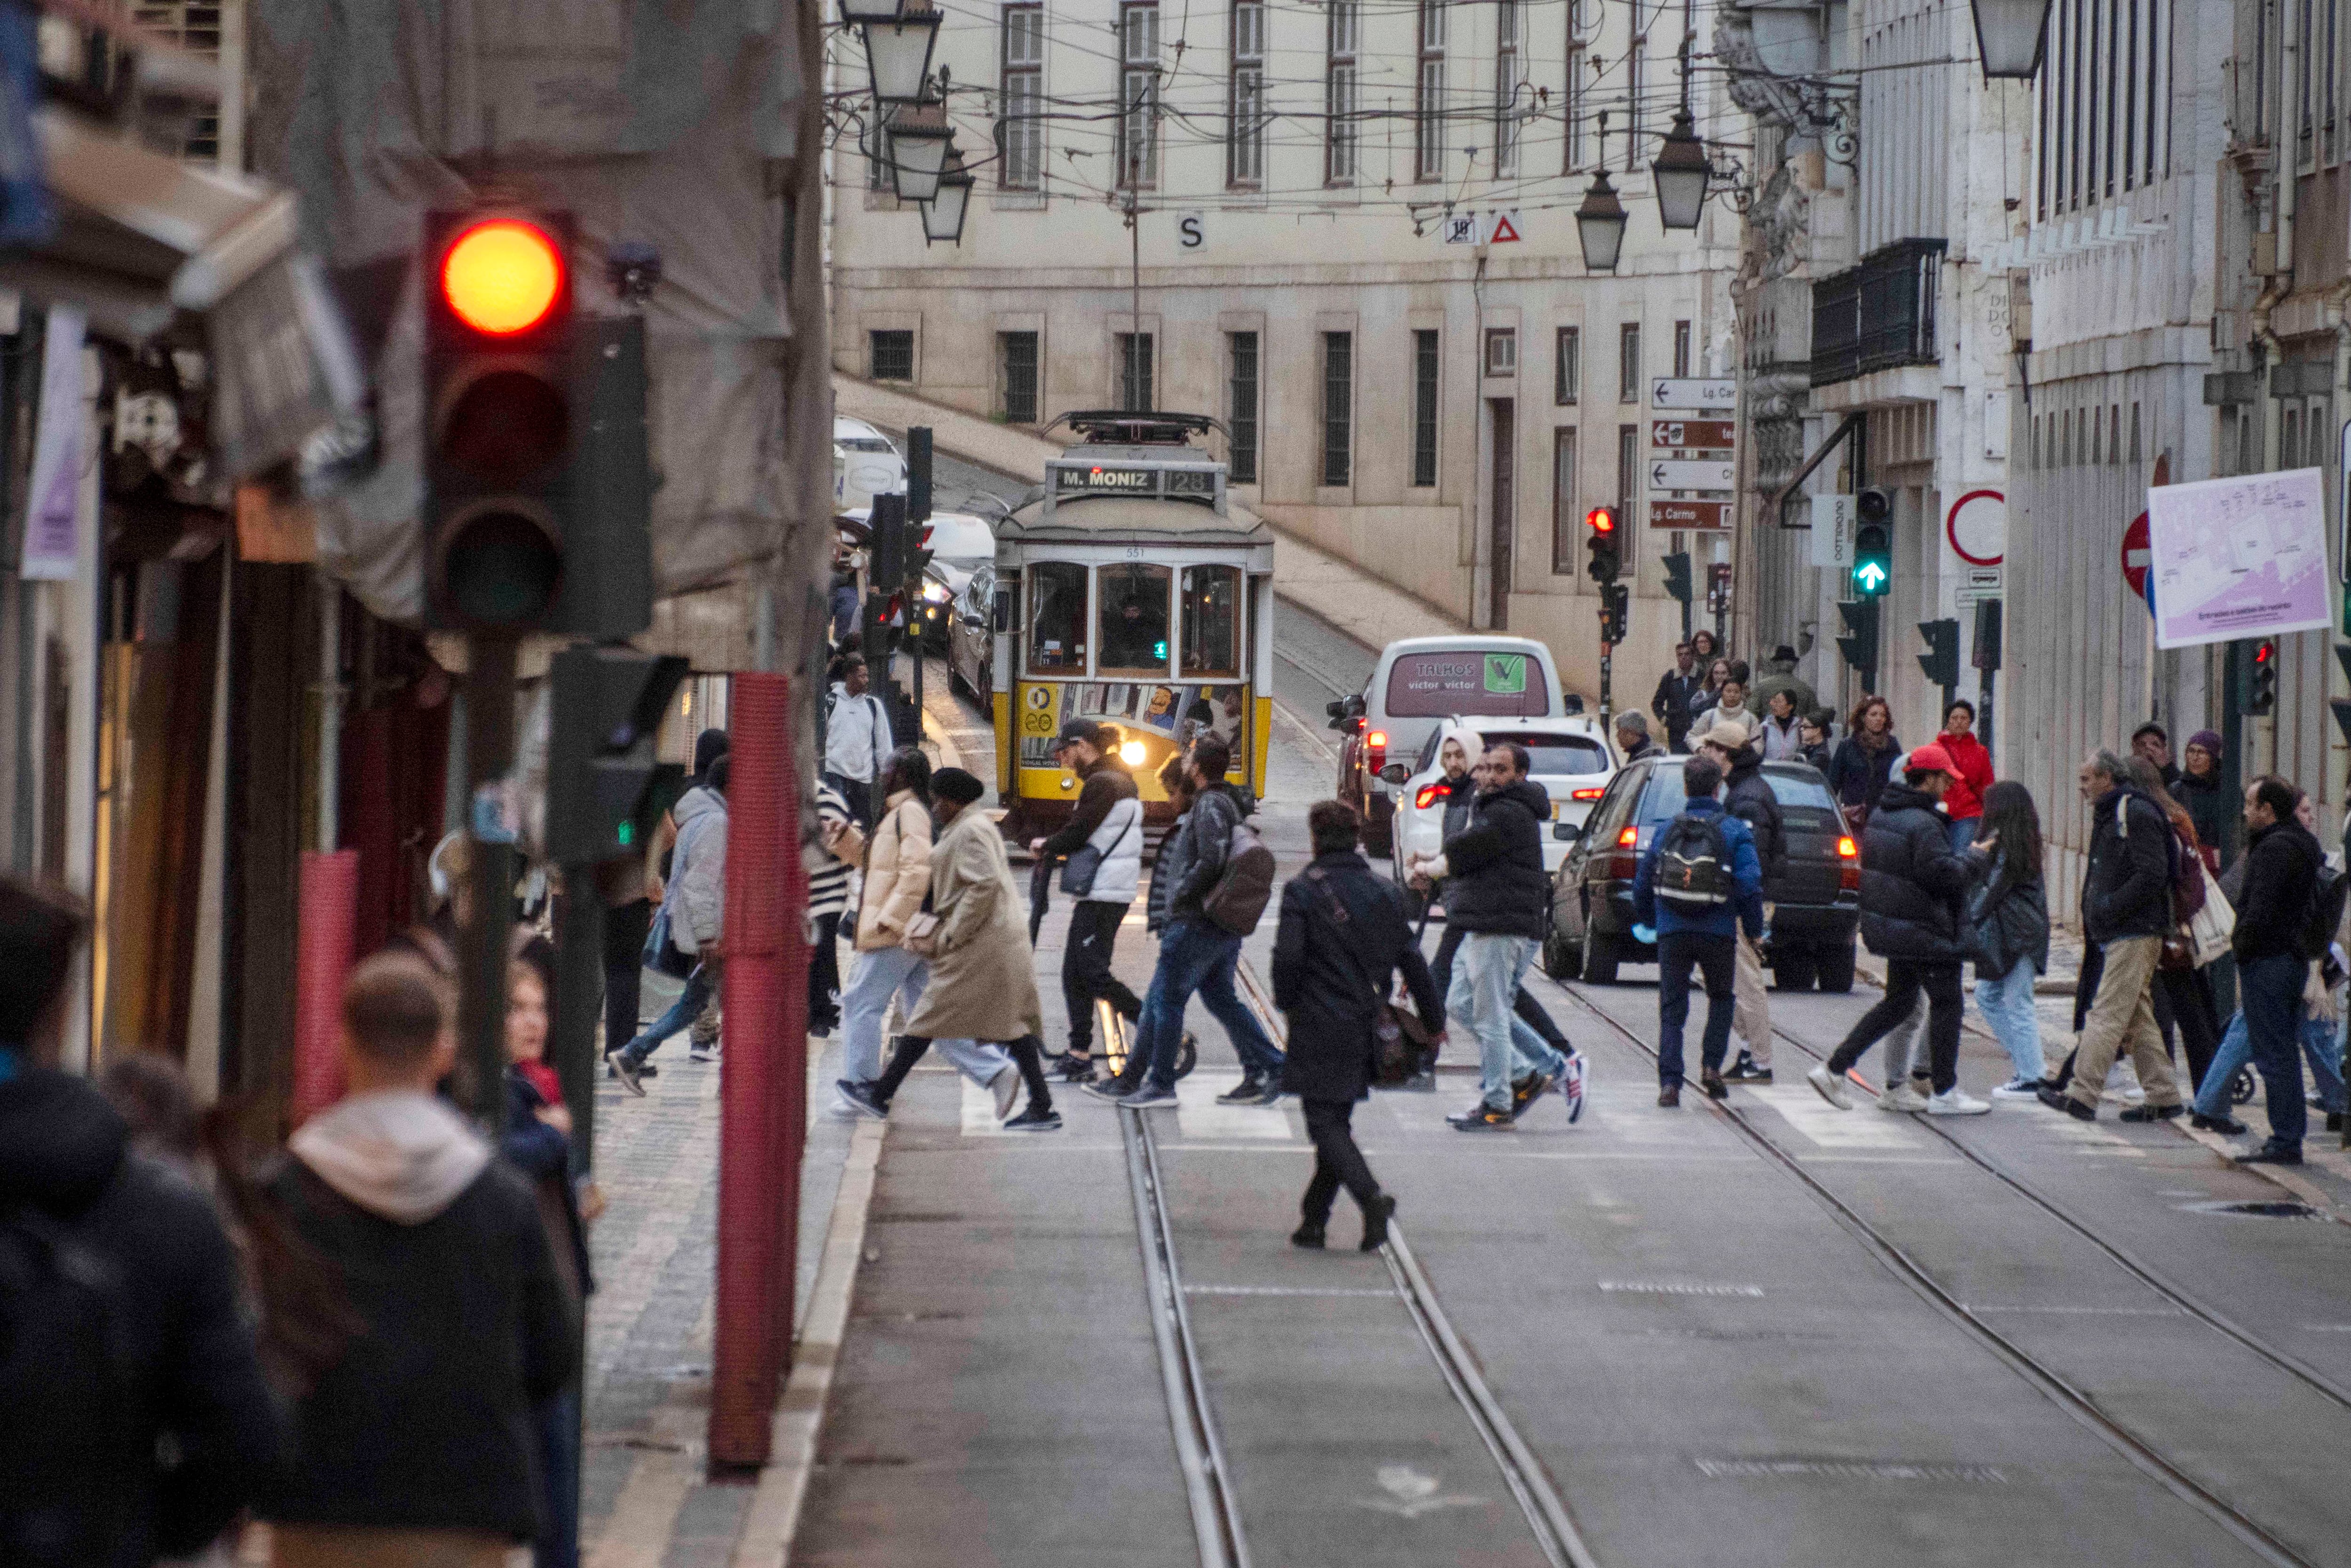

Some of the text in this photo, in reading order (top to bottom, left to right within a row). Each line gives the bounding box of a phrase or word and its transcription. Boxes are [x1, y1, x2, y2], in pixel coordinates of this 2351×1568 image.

[1181, 218, 1202, 247] S
[1064, 472, 1148, 487] M. MONIZ
[1175, 473, 1205, 492] 28
[1665, 508, 1696, 520] Carmo
[1416, 662, 1475, 677] TALHOS
[1408, 680, 1475, 690] victor victor
